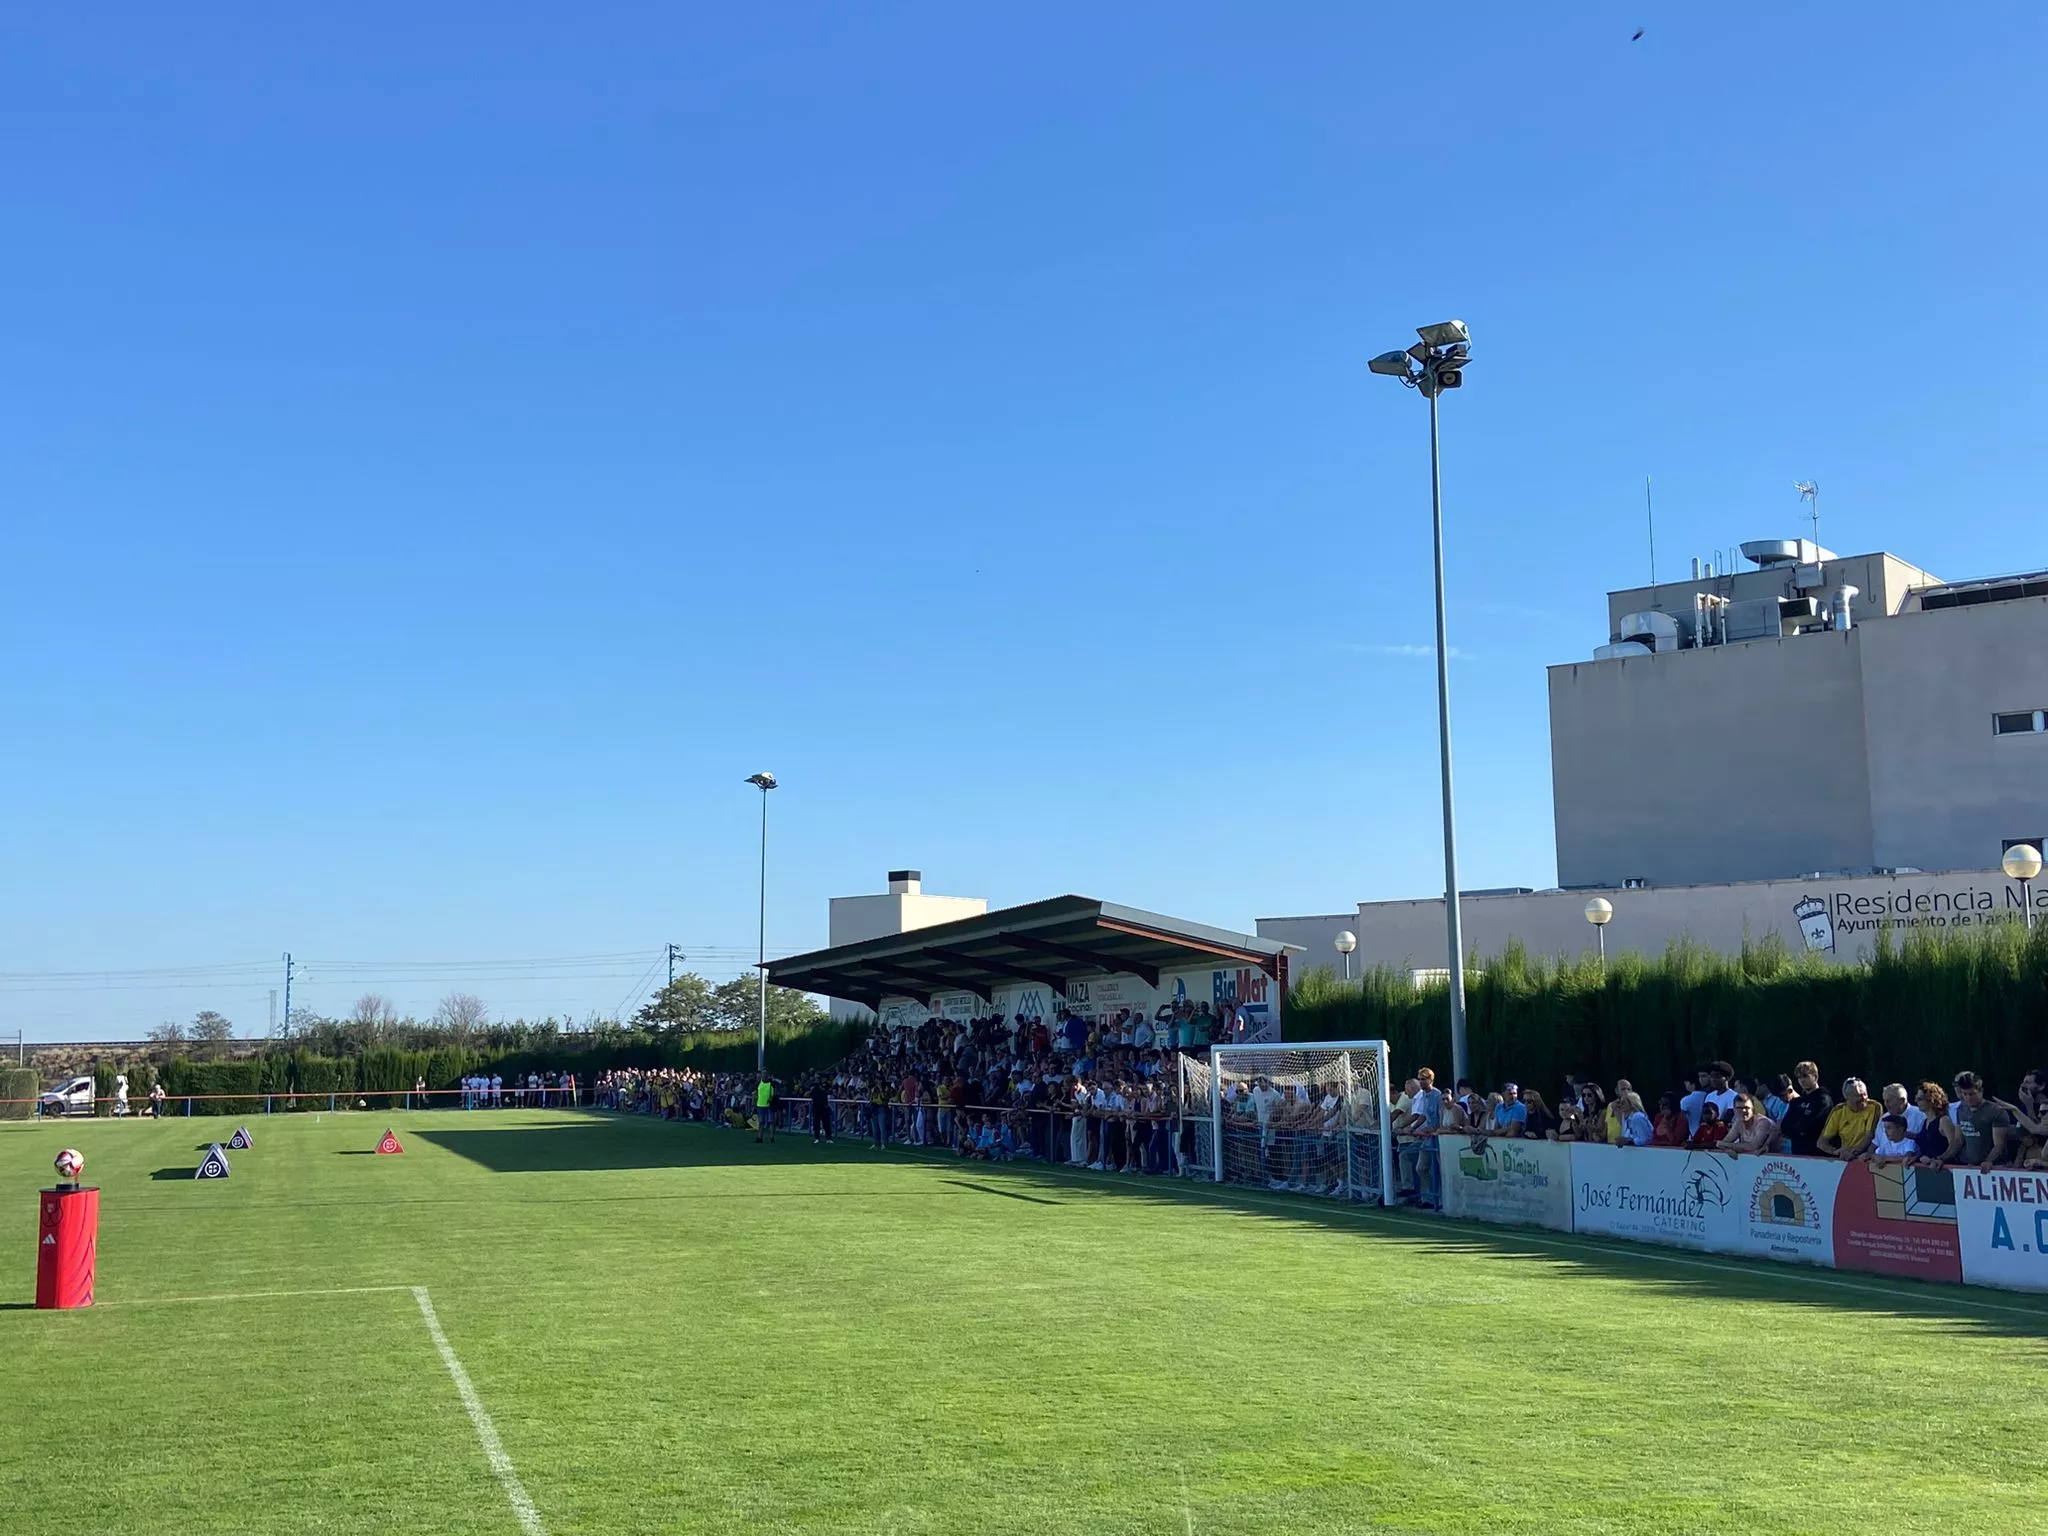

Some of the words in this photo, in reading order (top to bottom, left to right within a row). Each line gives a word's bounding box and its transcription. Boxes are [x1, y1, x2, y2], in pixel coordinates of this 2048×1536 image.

[1835, 887, 1993, 916] Residencia
[1837, 916, 1946, 934] Ayuntamiento
[1951, 913, 1971, 927] de
[1580, 1183, 1612, 1212] José
[1616, 1186, 1705, 1219] Fernández
[1749, 1176, 1763, 1223] IGNACIO
[1761, 1161, 1801, 1184] MONESMA
[1653, 1215, 1706, 1233] CATERING
